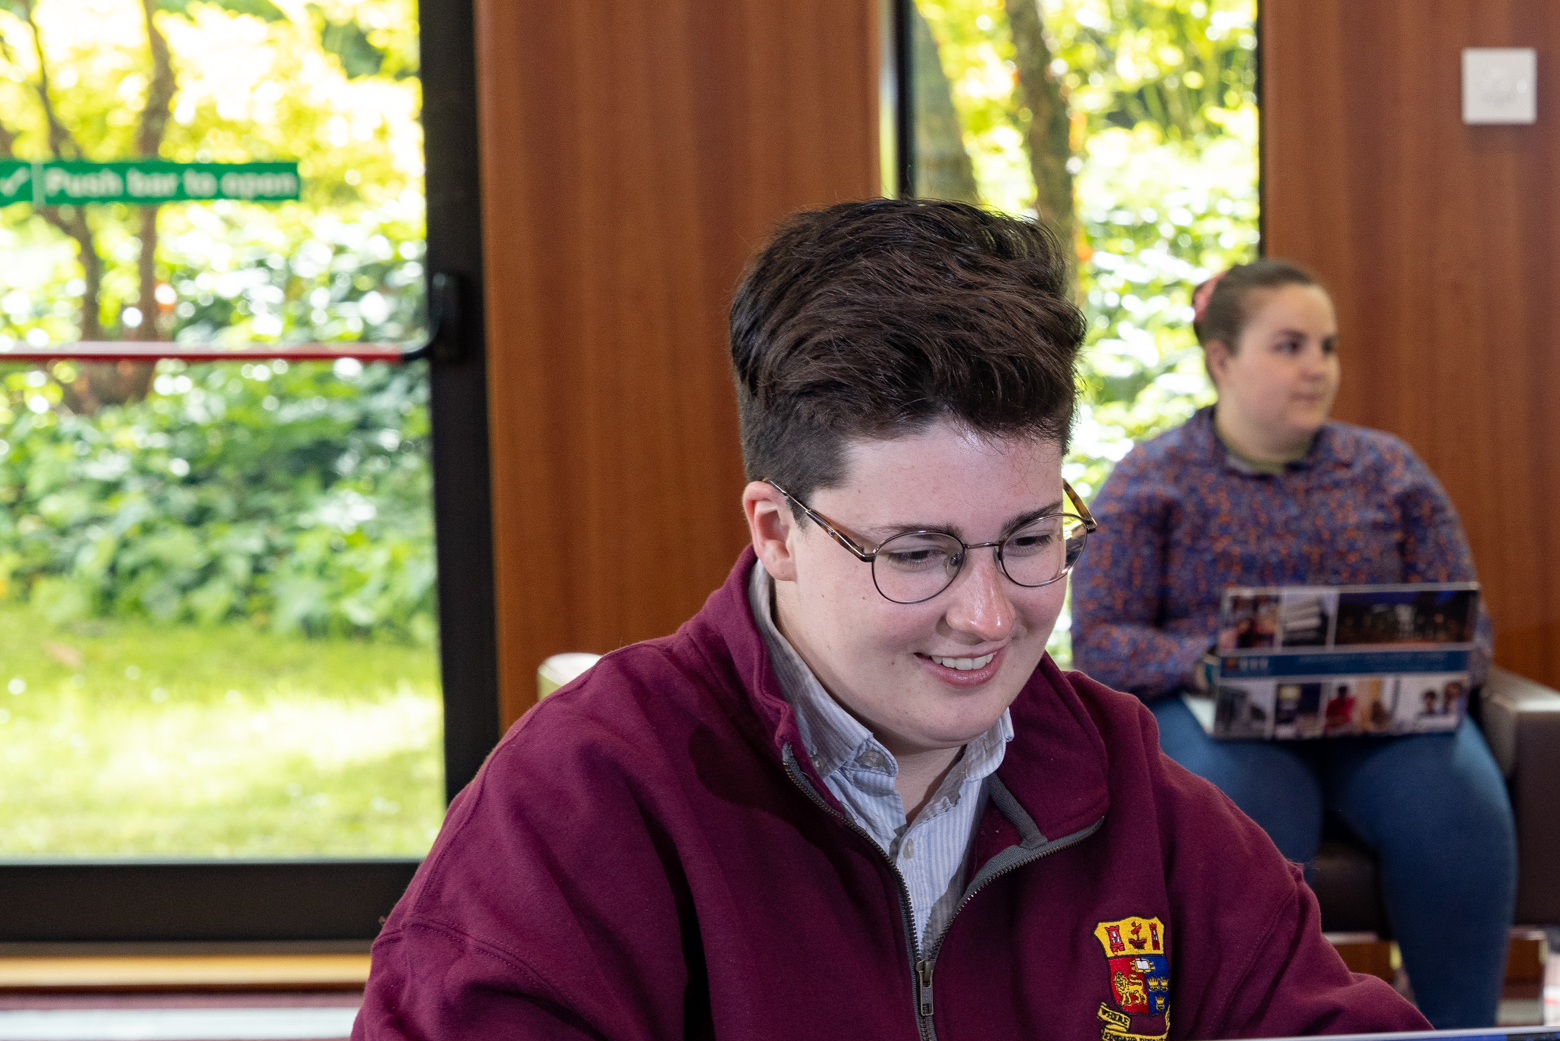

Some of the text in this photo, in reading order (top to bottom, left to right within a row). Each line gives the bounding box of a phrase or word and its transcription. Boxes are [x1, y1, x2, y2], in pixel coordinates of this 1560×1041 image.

[47, 168, 123, 197] Push
[127, 168, 178, 197] bar
[183, 168, 217, 197] to
